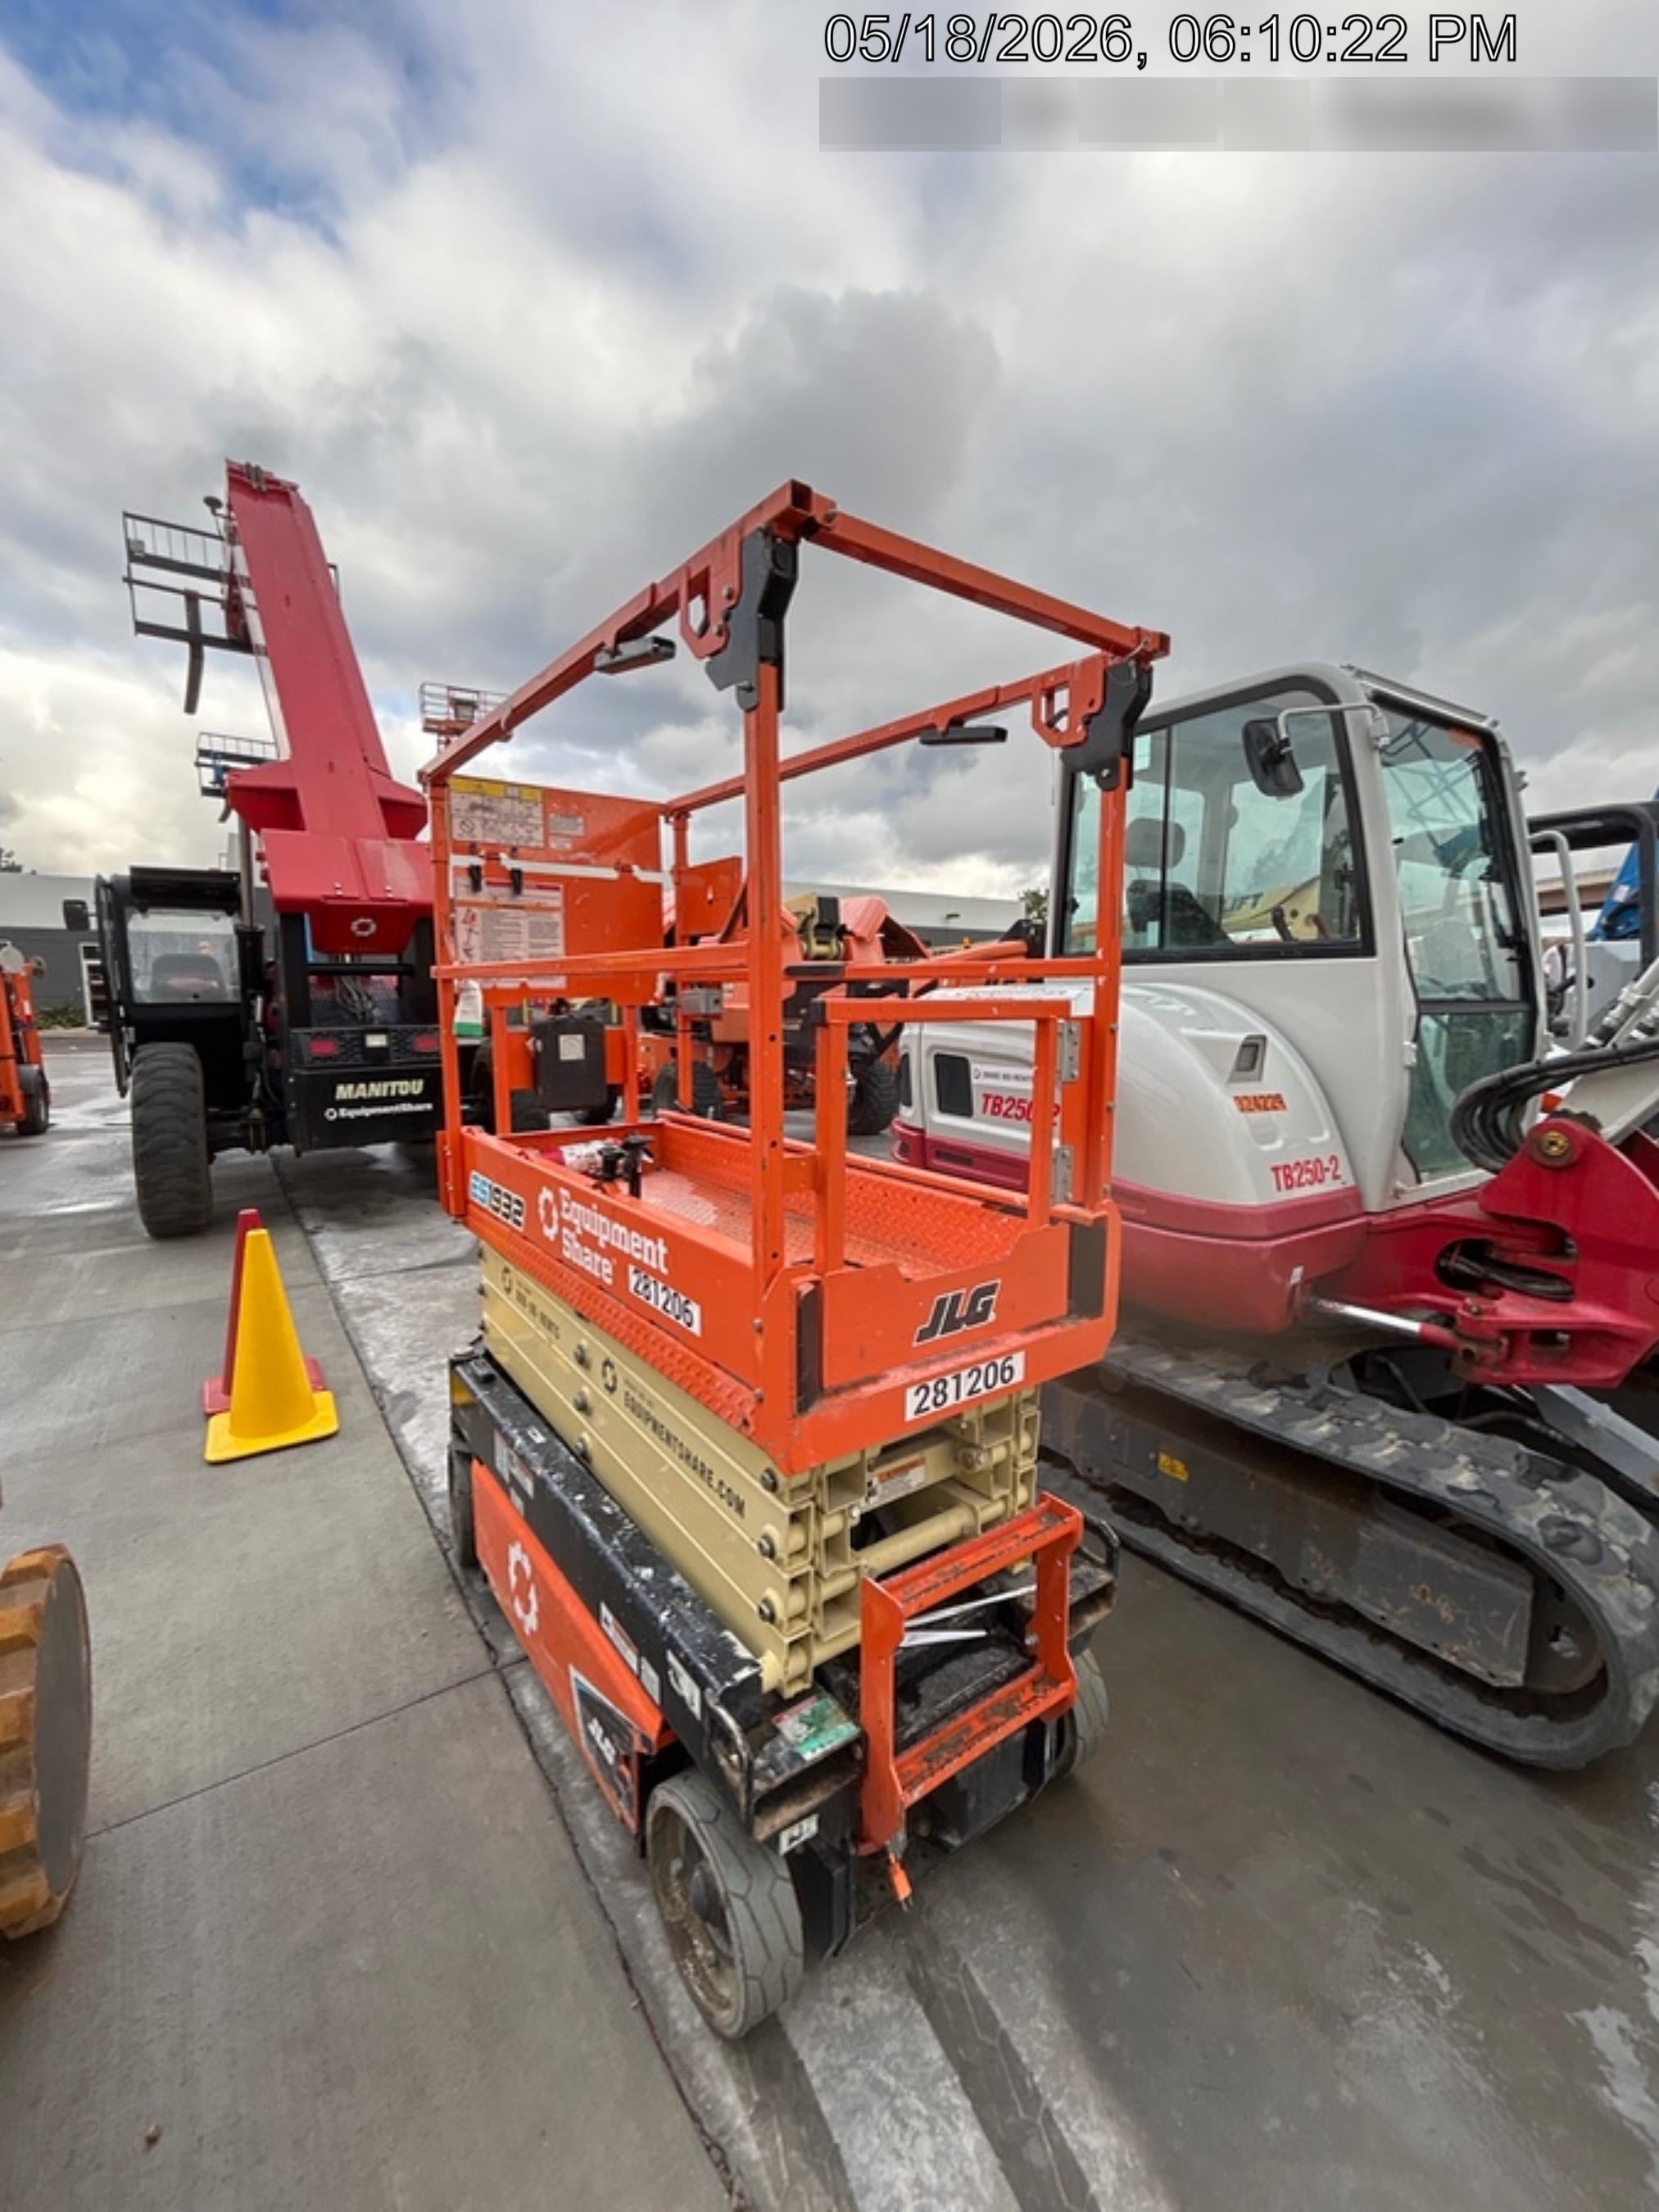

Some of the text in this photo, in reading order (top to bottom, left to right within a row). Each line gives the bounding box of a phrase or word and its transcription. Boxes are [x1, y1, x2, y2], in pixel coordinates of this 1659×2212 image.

[335, 1079, 424, 1101] MANITOU
[1271, 1155, 1343, 1192] TB250-2
[560, 1187, 670, 1276] Equipment
[562, 1226, 614, 1286] Share
[632, 1269, 695, 1329] 281206
[914, 1280, 1000, 1344] JLG
[913, 1355, 1015, 1416] 281206
[623, 1389, 746, 1520] EQUIPMENTSHARE.COM
